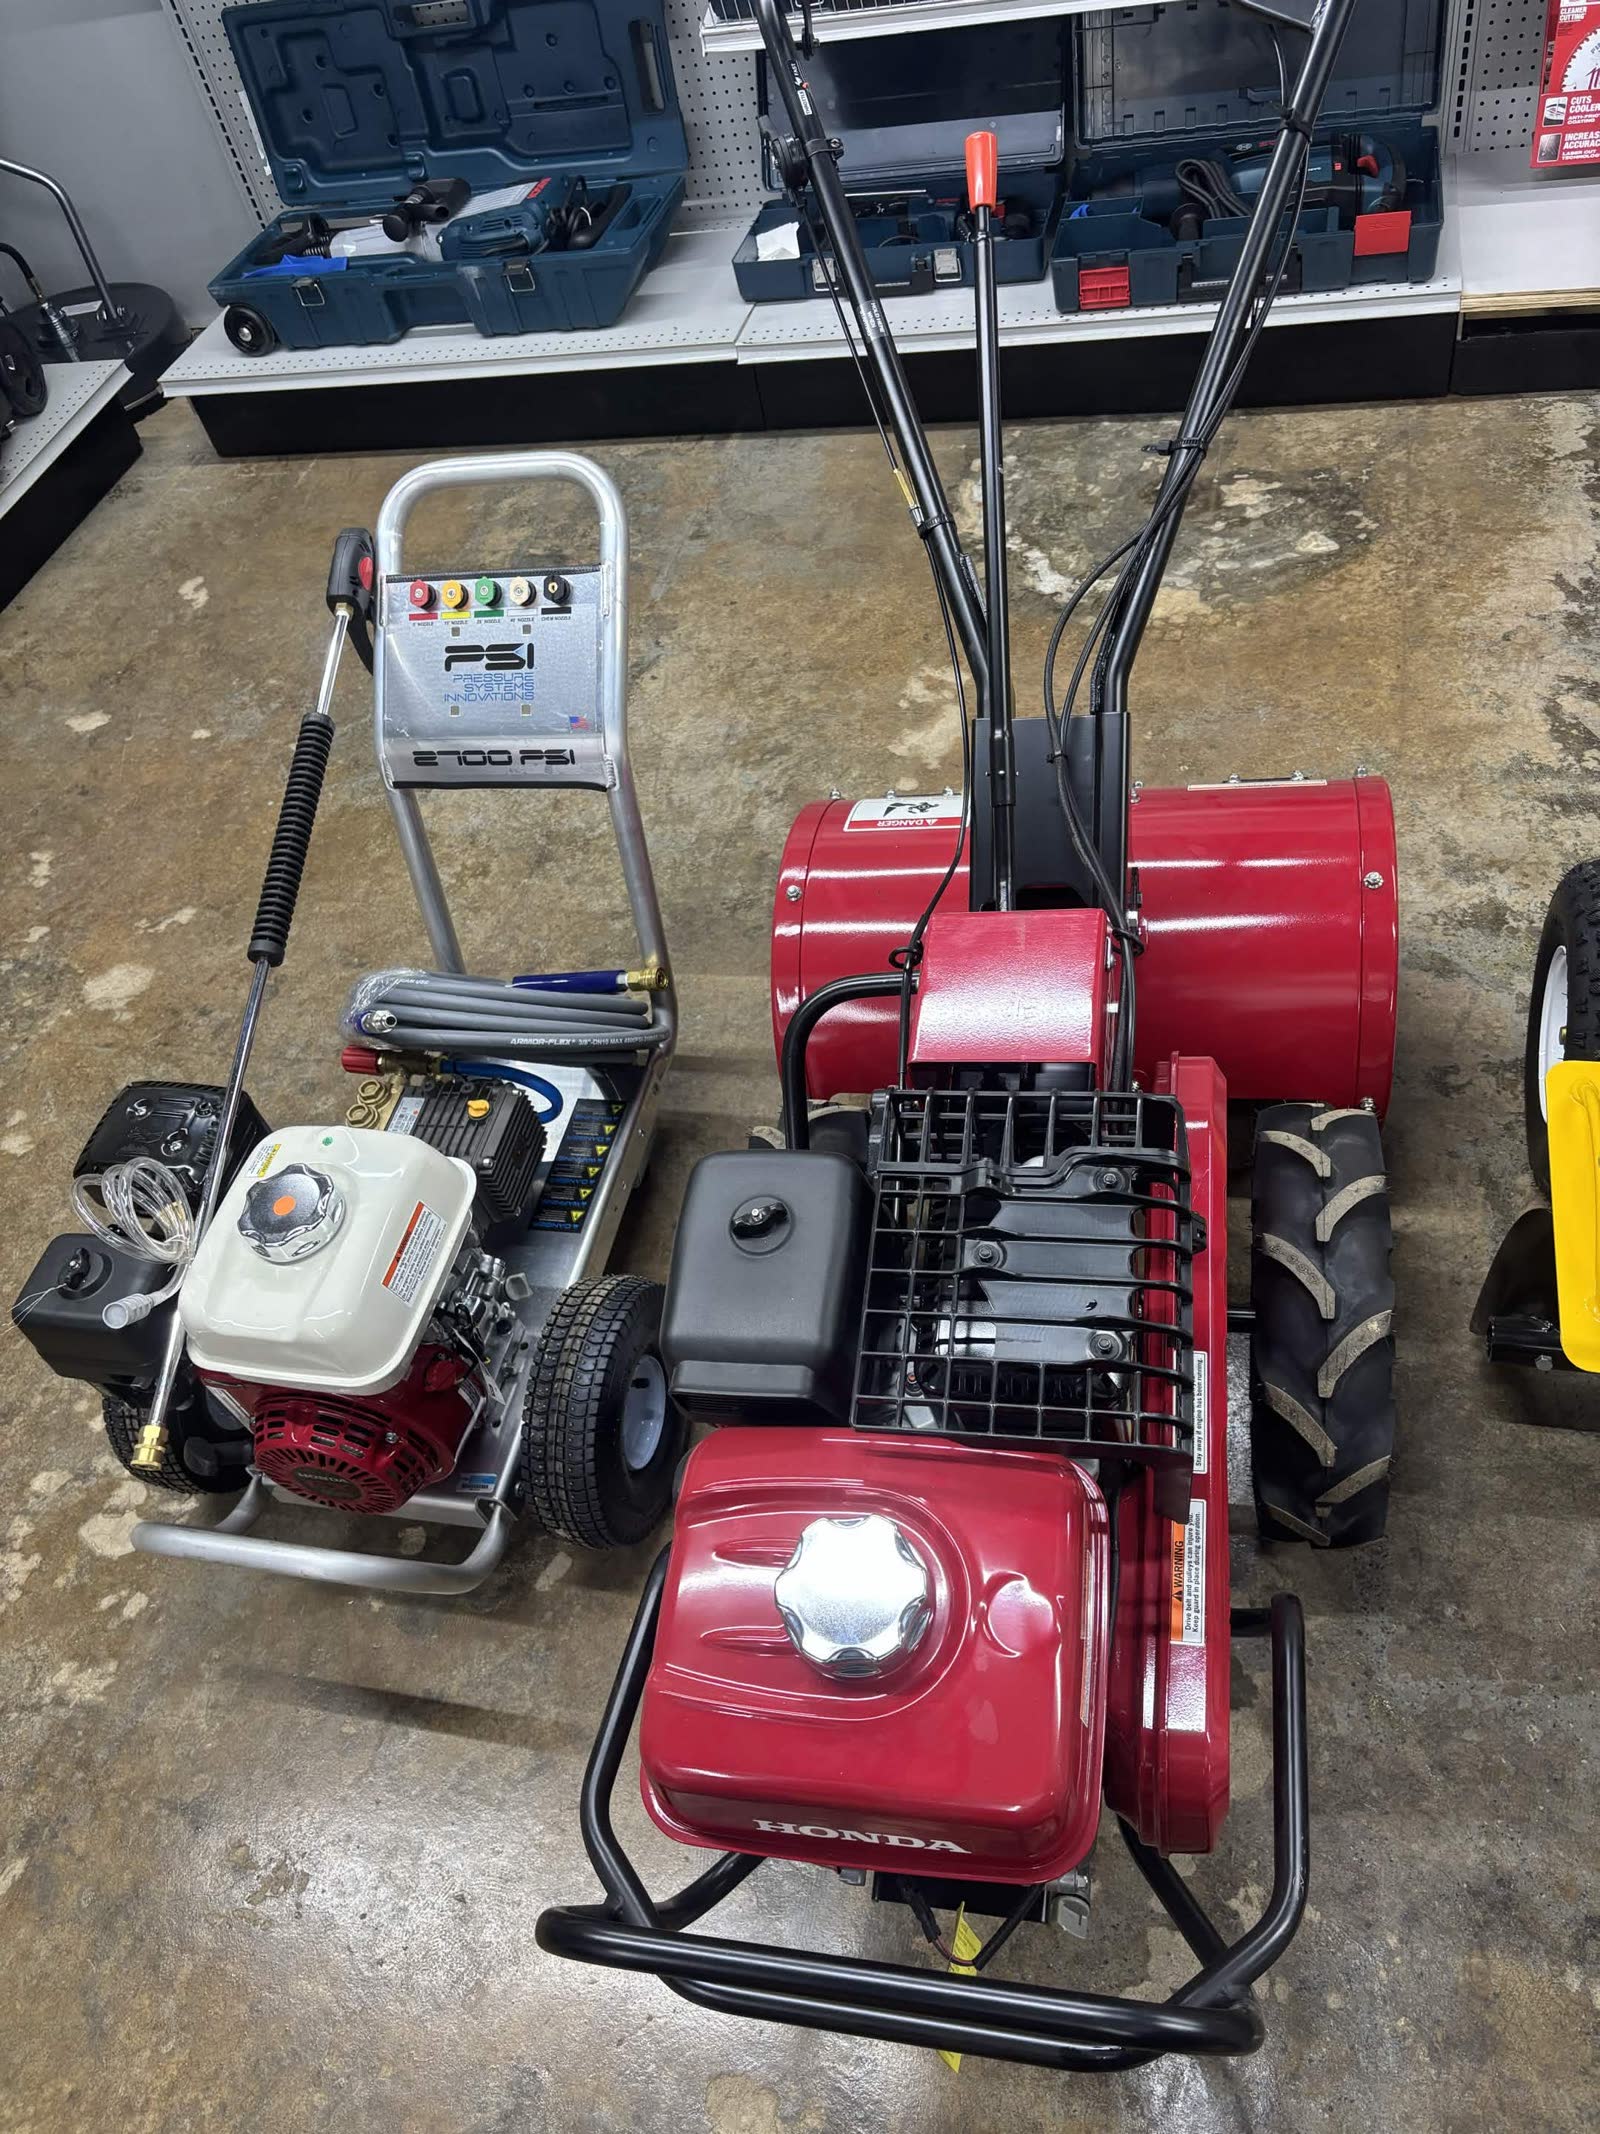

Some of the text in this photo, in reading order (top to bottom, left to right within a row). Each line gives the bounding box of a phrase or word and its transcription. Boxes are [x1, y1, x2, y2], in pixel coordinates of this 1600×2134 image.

[1571, 96, 1592, 105] CUTS
[871, 302, 885, 333] HOLD HERE
[444, 642, 534, 672] PSI
[453, 672, 534, 683] PRESSURE
[464, 682, 535, 692] SYSTEMS
[444, 692, 535, 702] INNOVATIONS
[412, 749, 575, 766] 2700 PSI
[877, 819, 925, 827] DANGER
[297, 1472, 350, 1484] HONDA
[1174, 1541, 1184, 1588] WARNING
[1186, 1561, 1194, 1584] pulleys
[1192, 1616, 1200, 1633] Keep
[752, 1819, 972, 1854] HONDA
